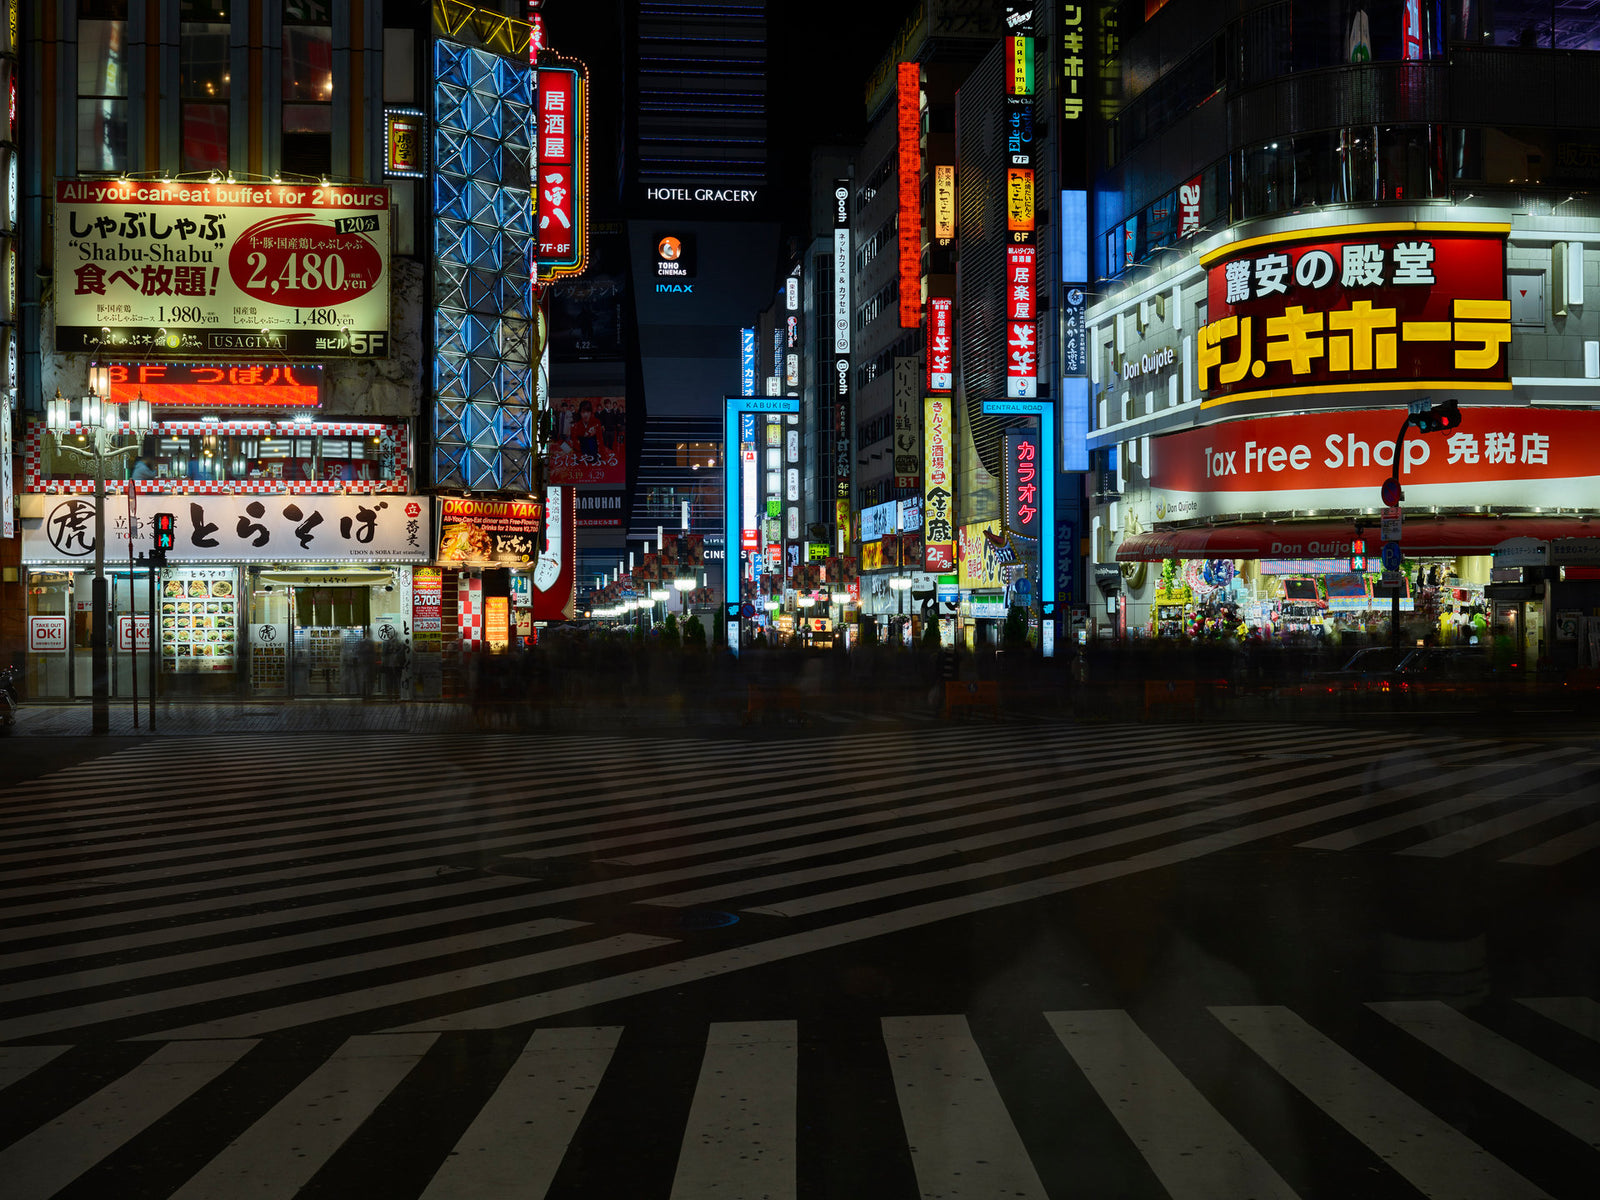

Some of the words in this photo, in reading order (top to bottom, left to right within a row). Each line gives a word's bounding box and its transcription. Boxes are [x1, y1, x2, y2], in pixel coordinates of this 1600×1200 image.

[545, 91, 565, 157] 居酒屋
[1009, 112, 1020, 128] de
[1009, 130, 1020, 152] Elle
[63, 183, 210, 204] All-you-can-eat
[218, 187, 272, 205] buffet
[277, 188, 305, 205] for
[312, 189, 324, 205] 2
[330, 190, 384, 207] hours
[647, 188, 692, 200] HOTEL
[695, 188, 758, 201] GRACERY
[69, 211, 226, 241] しゃぶしゃぶ
[339, 217, 376, 234] 120分
[1014, 233, 1028, 242] 6F
[246, 252, 345, 295] 2,480
[344, 278, 367, 290] yen
[1225, 241, 1436, 304] 驚安の殿堂
[656, 284, 693, 293] IMAX
[158, 306, 202, 324] 1,980
[201, 315, 219, 325] yen
[294, 309, 337, 326] 1,480
[337, 316, 354, 327] yen
[214, 335, 282, 348] USAGIYA
[316, 337, 348, 349] 当ビル
[350, 333, 384, 353] 5F
[1123, 361, 1140, 381] Don
[1141, 347, 1174, 375] Quijote
[931, 401, 944, 470] きんくら酒場
[553, 453, 619, 468] ちはやふる
[1205, 445, 1237, 478] Tax
[1245, 440, 1312, 474] Free
[1324, 433, 1431, 474] Shop
[1446, 432, 1550, 465] 免税店
[838, 482, 849, 490] 4F
[899, 477, 914, 488] B1
[1017, 441, 1037, 525] カラオケ
[444, 501, 507, 516] OKONOMI
[512, 503, 541, 517] YAKI
[927, 487, 952, 542] 金の蔵
[1167, 503, 1177, 513] Don
[1178, 500, 1197, 513] Quijote
[190, 501, 388, 550] とらそば
[927, 547, 944, 562] 2F
[1271, 541, 1302, 554] Don
[1308, 541, 1350, 557] Quijo
[36, 628, 61, 639] OK!
